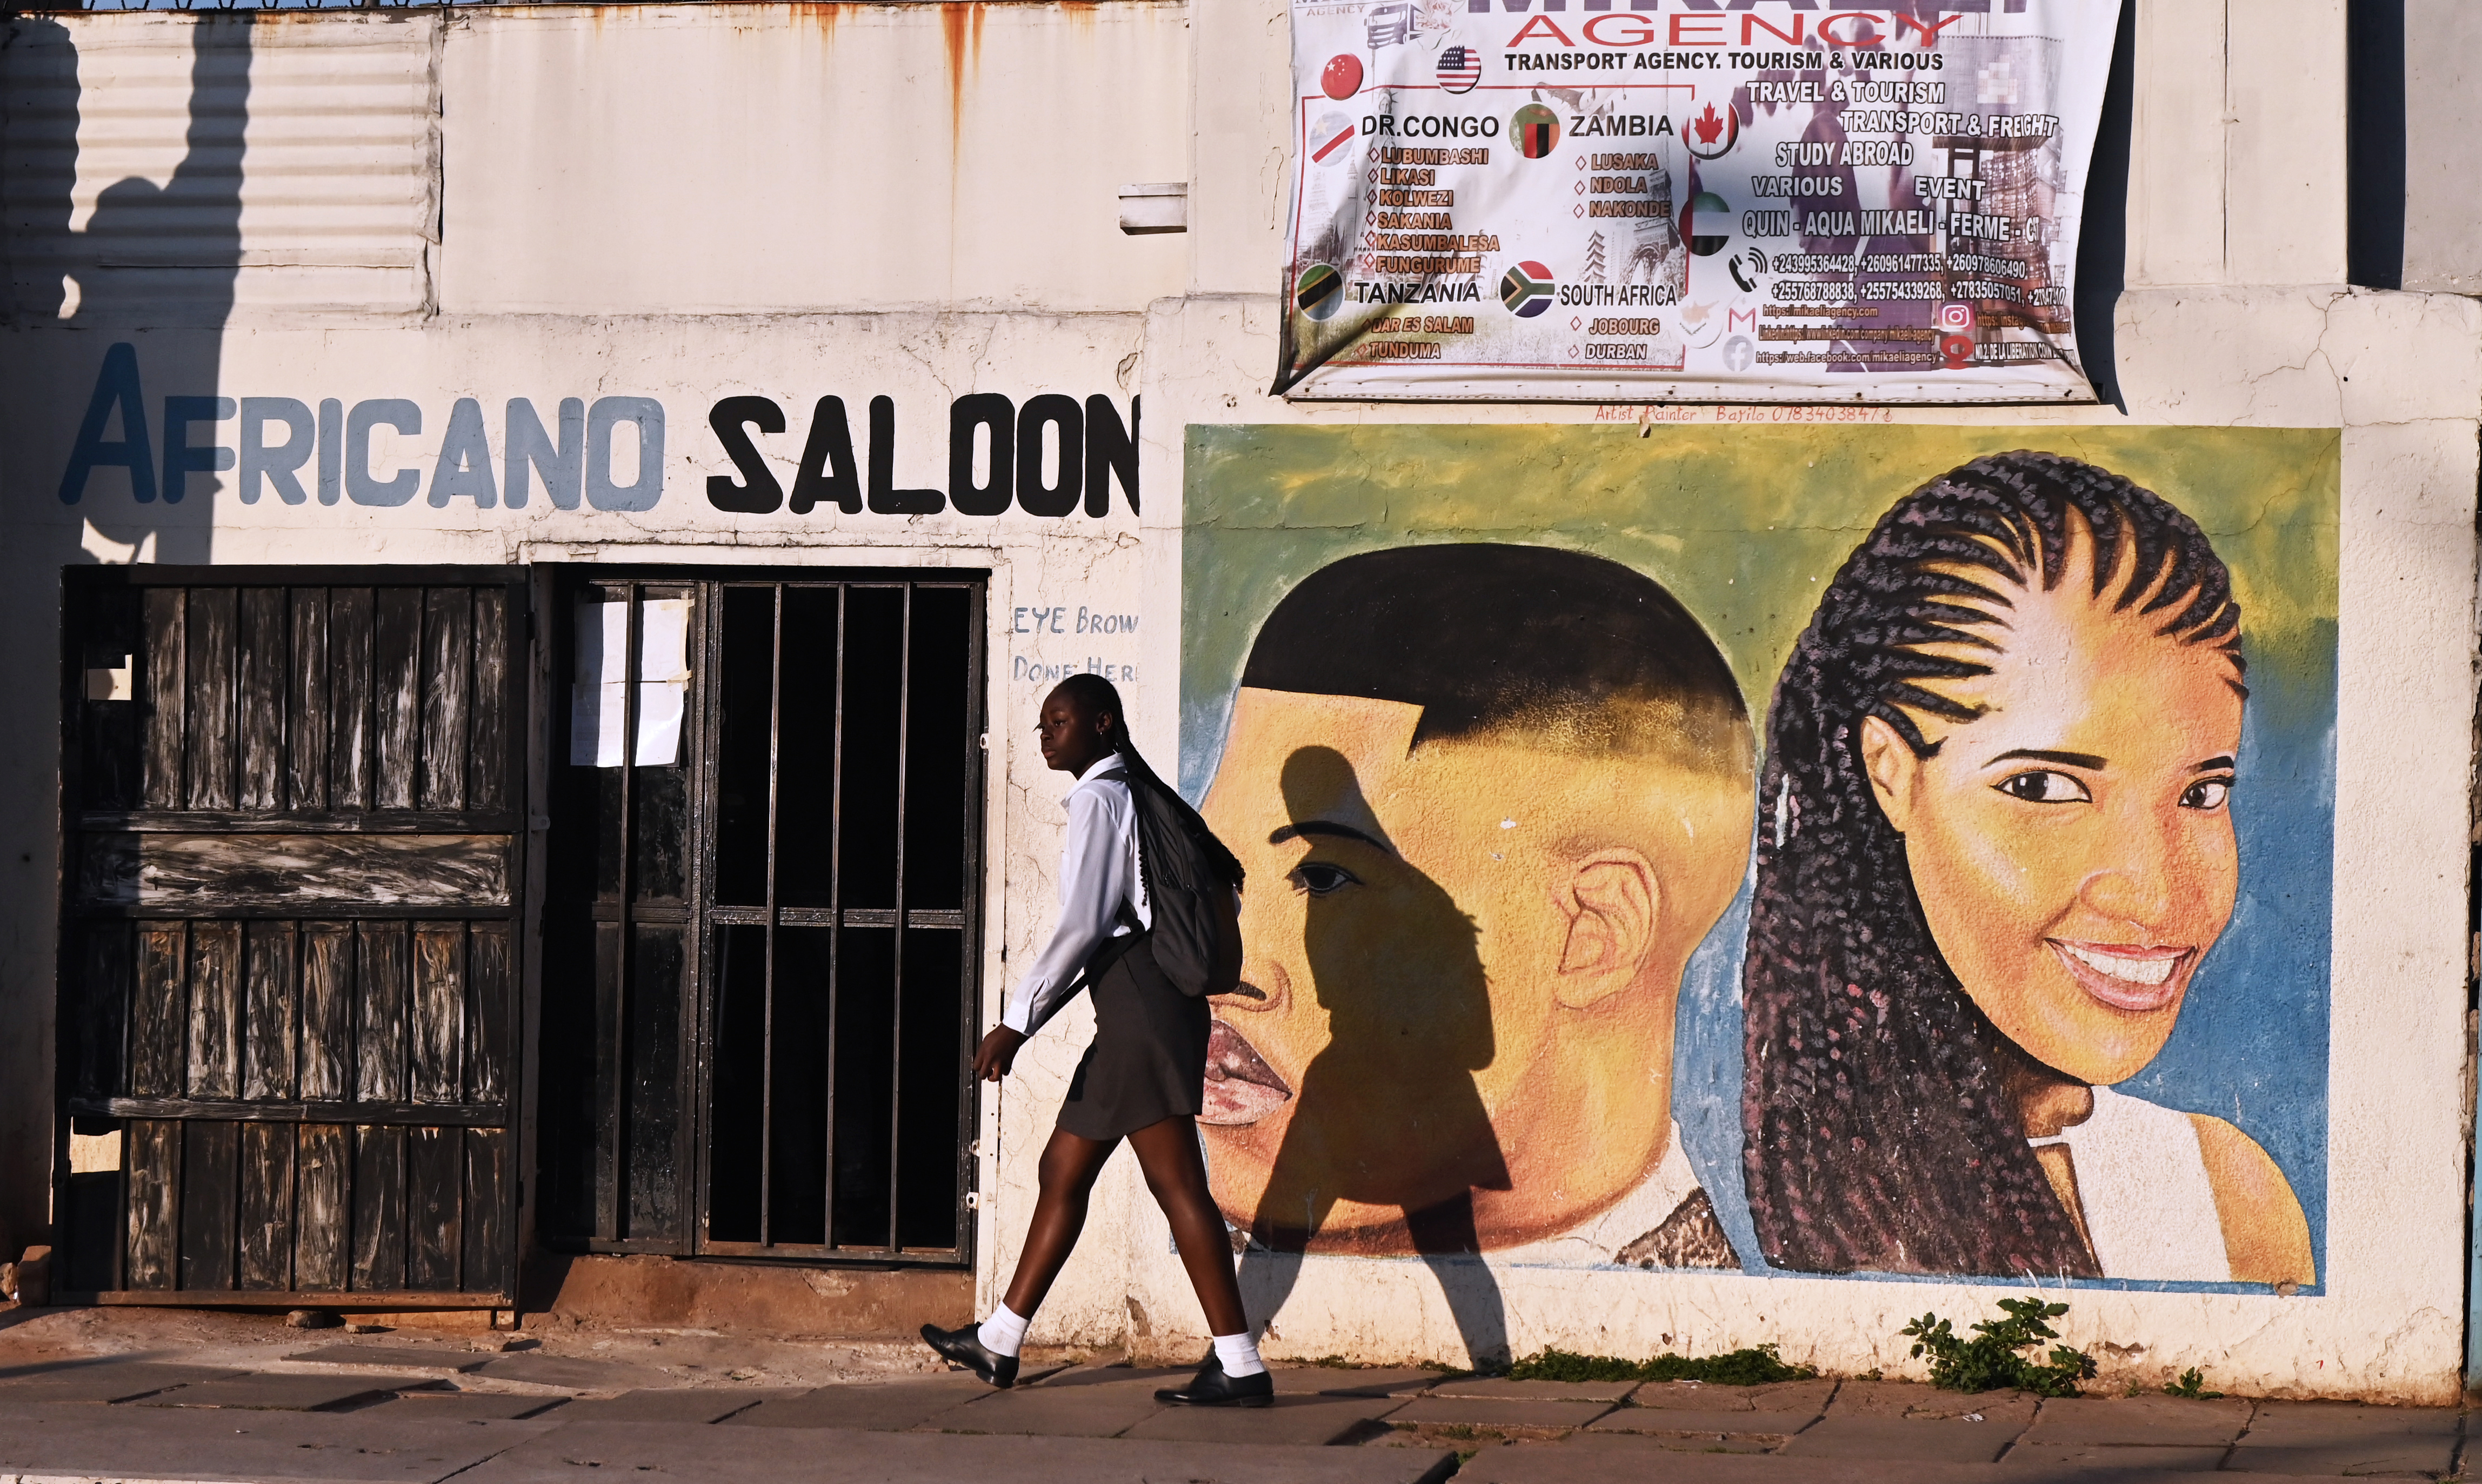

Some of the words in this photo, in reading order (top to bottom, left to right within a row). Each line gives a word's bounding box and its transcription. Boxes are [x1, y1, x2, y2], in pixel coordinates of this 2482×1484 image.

[1307, 5, 1365, 16] AGENCY
[1506, 13, 1964, 47] AGENCY
[1505, 52, 1627, 70] TRANSPORT
[1633, 52, 1720, 69] AGENCY.
[1728, 52, 1822, 69] TOURISM
[1830, 52, 1844, 69] &
[1852, 52, 1944, 70] VARIOUS
[1746, 81, 1825, 103] TRAVEL
[1831, 80, 1846, 102] &
[1852, 81, 1945, 104] TOURISM
[1362, 115, 1499, 137] DR.CONGO
[1569, 115, 1674, 136] ZAMBIA
[1840, 110, 1962, 135] TRANSPORT
[1966, 114, 1981, 137] &
[1987, 113, 2059, 138] FREIGHT
[1382, 146, 1489, 165] LUBUMBASHI
[1591, 153, 1659, 171] LUSAKA
[1776, 142, 1836, 167] STUDY
[1839, 141, 1913, 166] ABROAD
[1380, 168, 1435, 185] LIKASI
[1590, 176, 1647, 193] NDOLA
[1751, 175, 1843, 197] VARIOUS
[1914, 176, 1986, 201] EVENT
[1379, 189, 1453, 207] KOLWEZI
[1589, 200, 1671, 219] NAKONDE
[1378, 212, 1452, 229] SAKANIA
[1742, 210, 1790, 238] QUIN
[1804, 211, 1855, 238] AQUA
[1860, 210, 1934, 236] MIKAELI
[1950, 212, 2010, 240] FERME
[1377, 233, 1500, 251] KASUMBALESA
[1376, 256, 1481, 273] FUNGURUME
[1772, 253, 1858, 277] +243995364428,
[1860, 252, 1944, 275] +260961477335,
[1355, 283, 1480, 304] TANZANIA
[1560, 285, 1614, 306] SOUTH
[1618, 285, 1677, 306] AFRICA
[1772, 281, 1858, 304] +255768788838,
[1860, 281, 1946, 303] +255754339268,
[1763, 304, 1878, 319] https://mikaeliagency.com
[1372, 317, 1400, 333] DAR
[1403, 317, 1421, 332] ES
[1424, 316, 1474, 334] SALAM
[1589, 318, 1660, 335] JOBOURG
[1369, 341, 1441, 359] TUNDUMA
[1585, 344, 1647, 359] DURBAN
[1990, 342, 1999, 359] DE
[1999, 342, 2006, 359] LA
[2006, 342, 2038, 359] LIBERATION
[1595, 405, 1634, 420] Artist
[1643, 405, 1696, 420] Painter
[59, 342, 665, 511] AFRICANO
[706, 393, 1139, 518] SALOON
[1015, 607, 1066, 633] EYE
[1076, 606, 1138, 634] BROW
[1013, 656, 1078, 681] DONE
